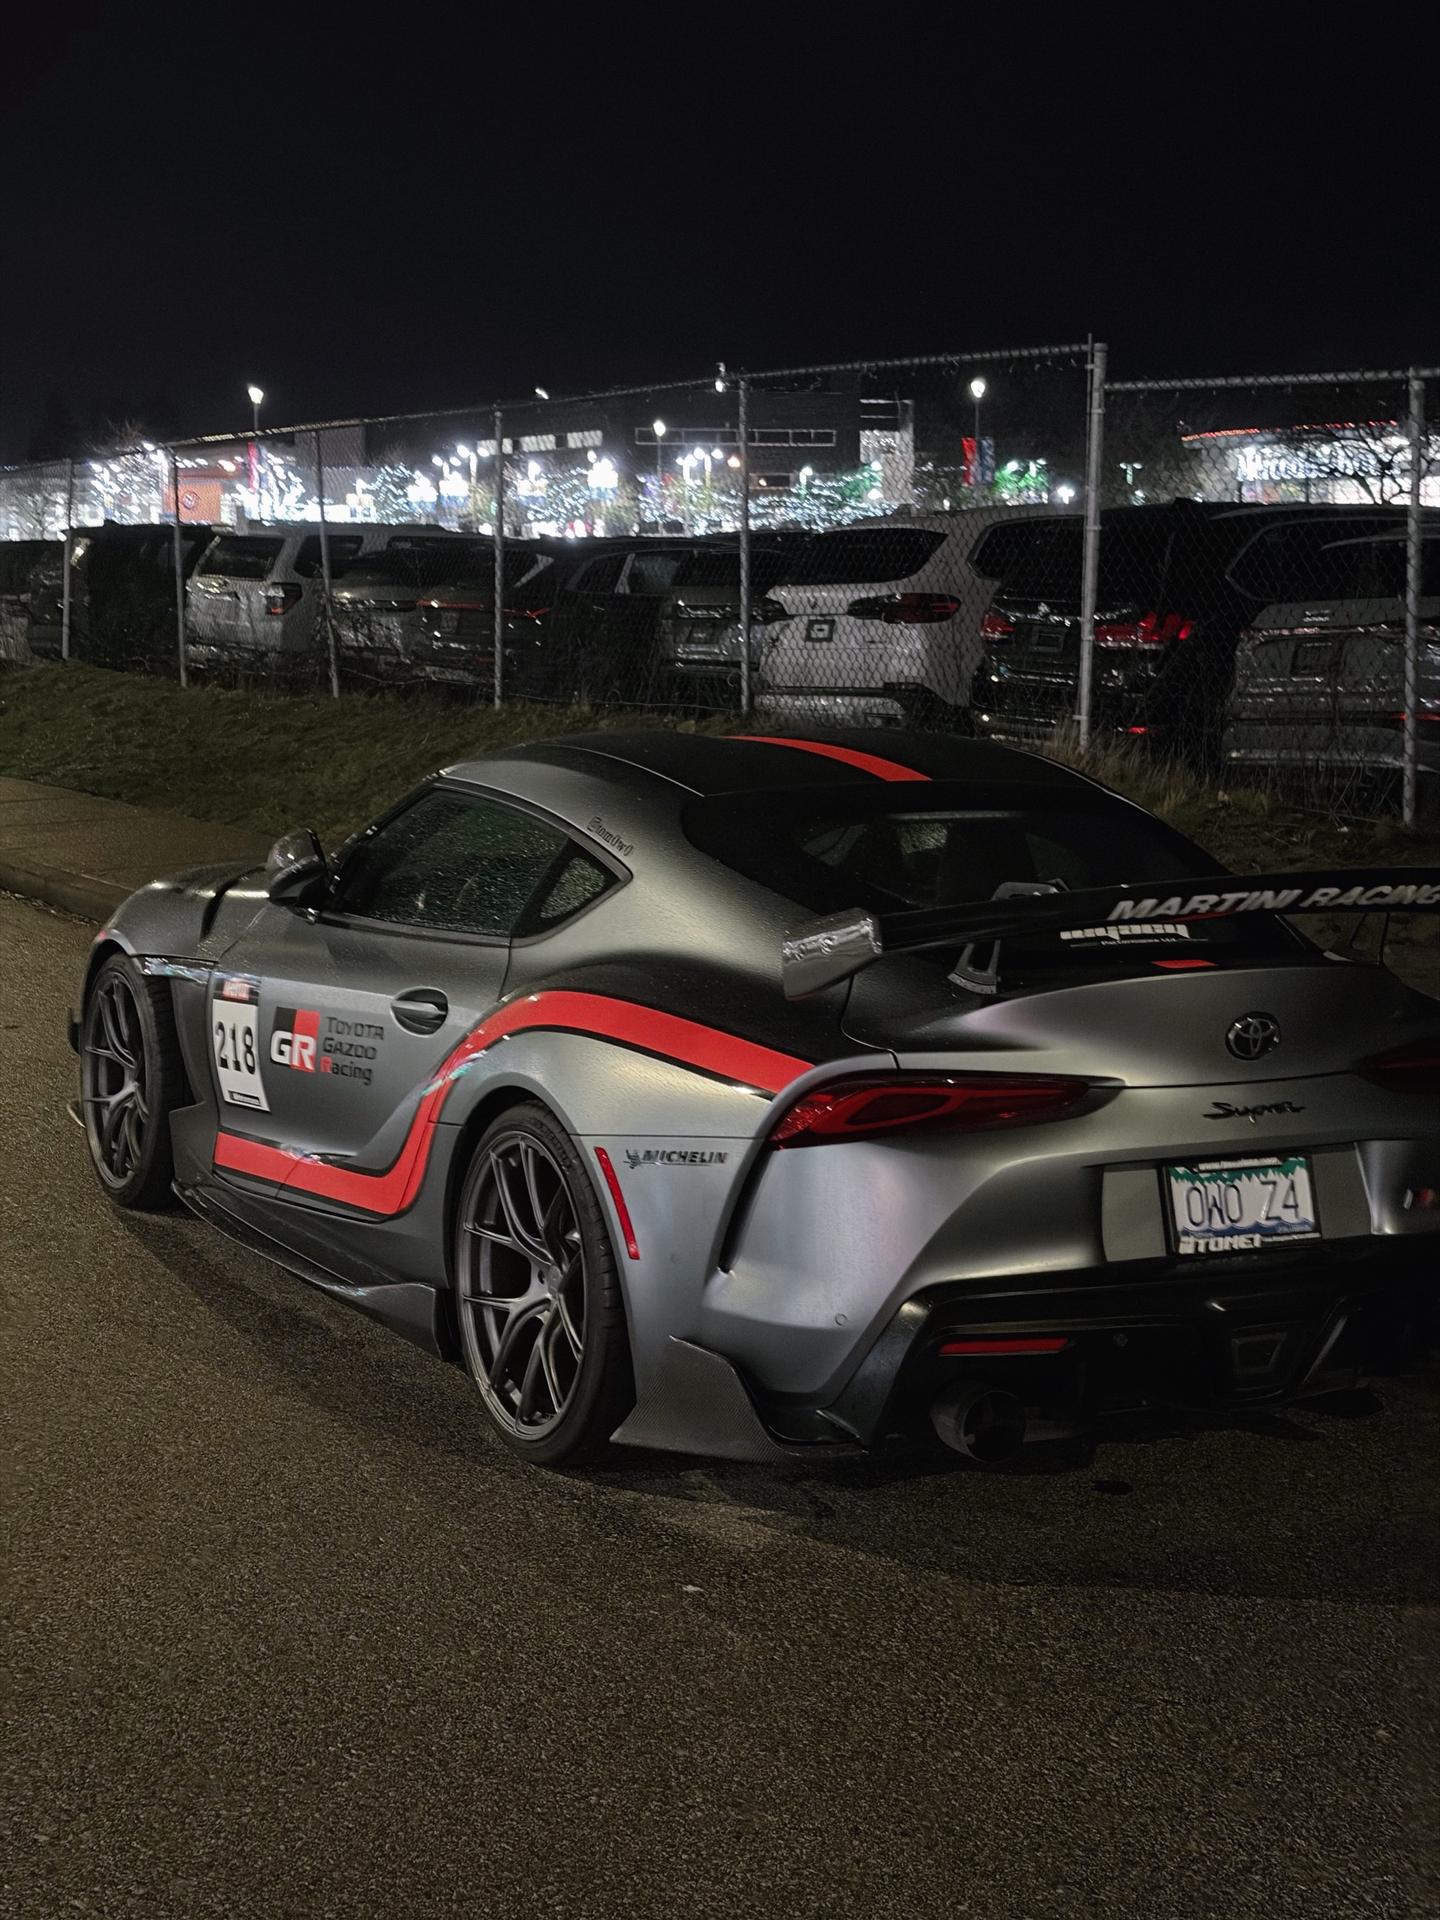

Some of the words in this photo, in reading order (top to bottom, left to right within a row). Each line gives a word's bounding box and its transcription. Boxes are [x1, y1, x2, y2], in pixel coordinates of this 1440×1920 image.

[1107, 888, 1303, 920] MARTINI
[1300, 884, 1440, 908] RACING
[325, 1016, 385, 1041] TOYOTA
[215, 1021, 256, 1075] 218
[270, 1029, 317, 1070] GR
[322, 1036, 377, 1060] GAZOO
[320, 1056, 373, 1085] Racing
[642, 1149, 728, 1164] MICHELIN
